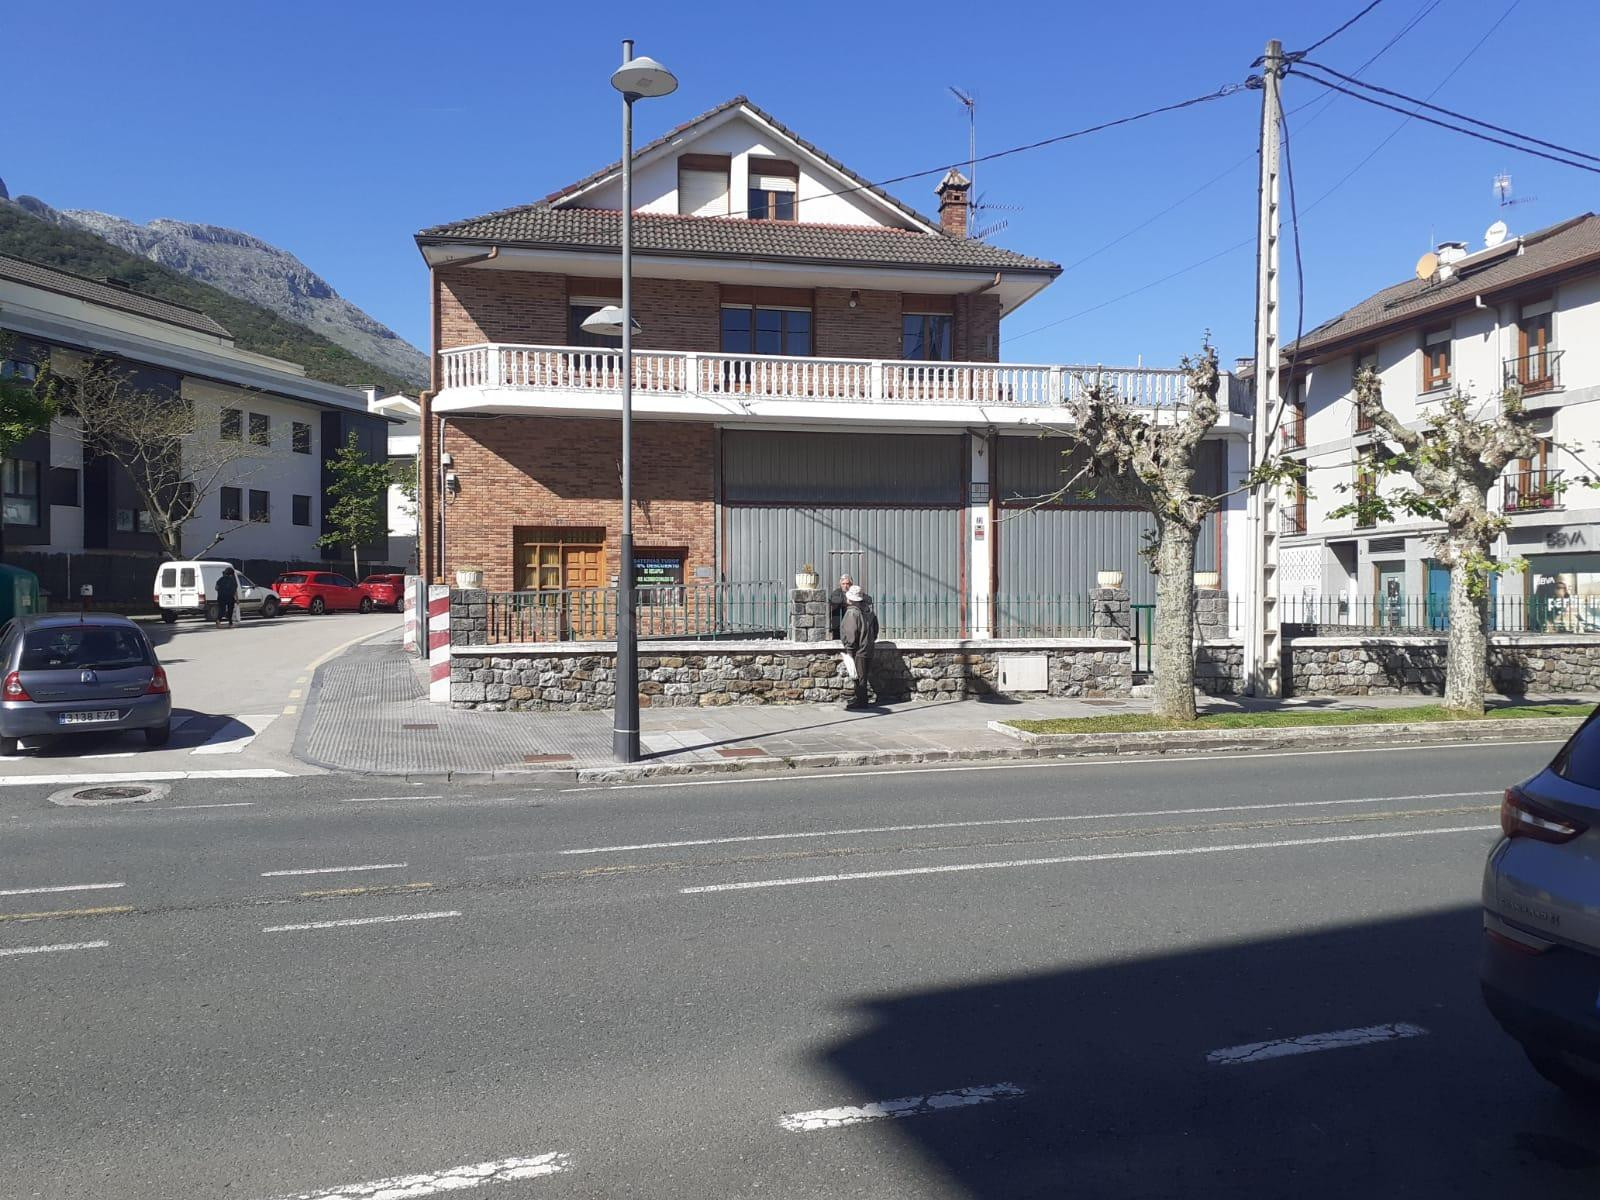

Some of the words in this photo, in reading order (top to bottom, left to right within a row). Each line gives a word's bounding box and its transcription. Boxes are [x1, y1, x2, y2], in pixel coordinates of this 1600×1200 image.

[1546, 530, 1586, 547] BBVA
[66, 712, 94, 723] 3138
[96, 711, 117, 721] FZP
